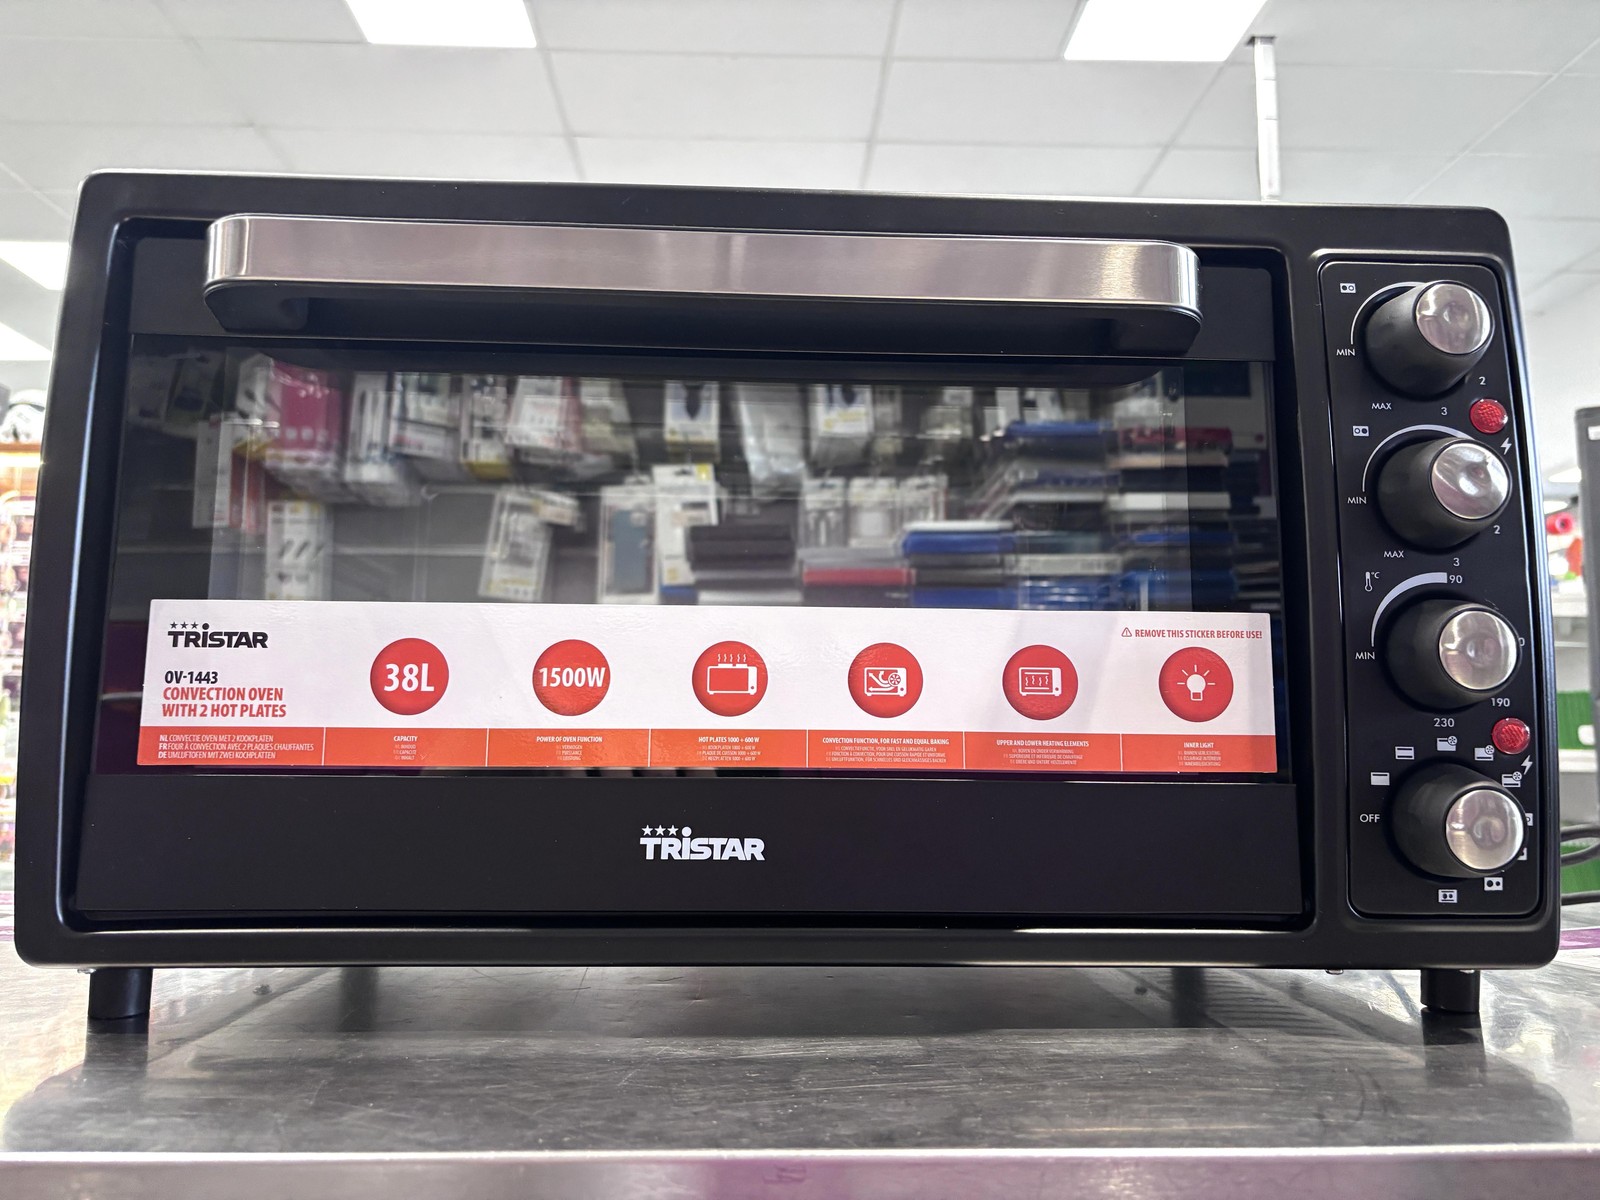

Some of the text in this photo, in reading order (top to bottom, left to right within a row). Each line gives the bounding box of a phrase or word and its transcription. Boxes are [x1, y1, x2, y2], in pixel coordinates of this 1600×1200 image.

[1336, 348, 1356, 357] MIN
[1478, 376, 1487, 385] 2
[1371, 402, 1392, 410] MAX
[1441, 407, 1448, 416] 3
[1347, 496, 1367, 504] MIN
[1493, 525, 1501, 534] 2
[1384, 550, 1404, 558] MAX
[1453, 558, 1460, 566] 3
[1449, 575, 1463, 584] 90
[1135, 629, 1263, 639] REMOVE THIS STICKER BEFORE USE!
[1355, 652, 1375, 660] MIN
[164, 671, 218, 684] OV-1443
[383, 662, 435, 692] 38L
[538, 667, 606, 687] 1500W
[163, 687, 284, 701] CONVECTION OVEN
[1490, 697, 1511, 707] 190
[161, 703, 287, 718] WITH 2 HOT PLATES
[1433, 718, 1455, 728] 230
[247, 743, 273, 751] PLAQUES
[158, 751, 167, 759] DE
[207, 751, 219, 759] MIT
[235, 751, 276, 759] KOCHPLATTEN
[1359, 813, 1381, 823] OFF
